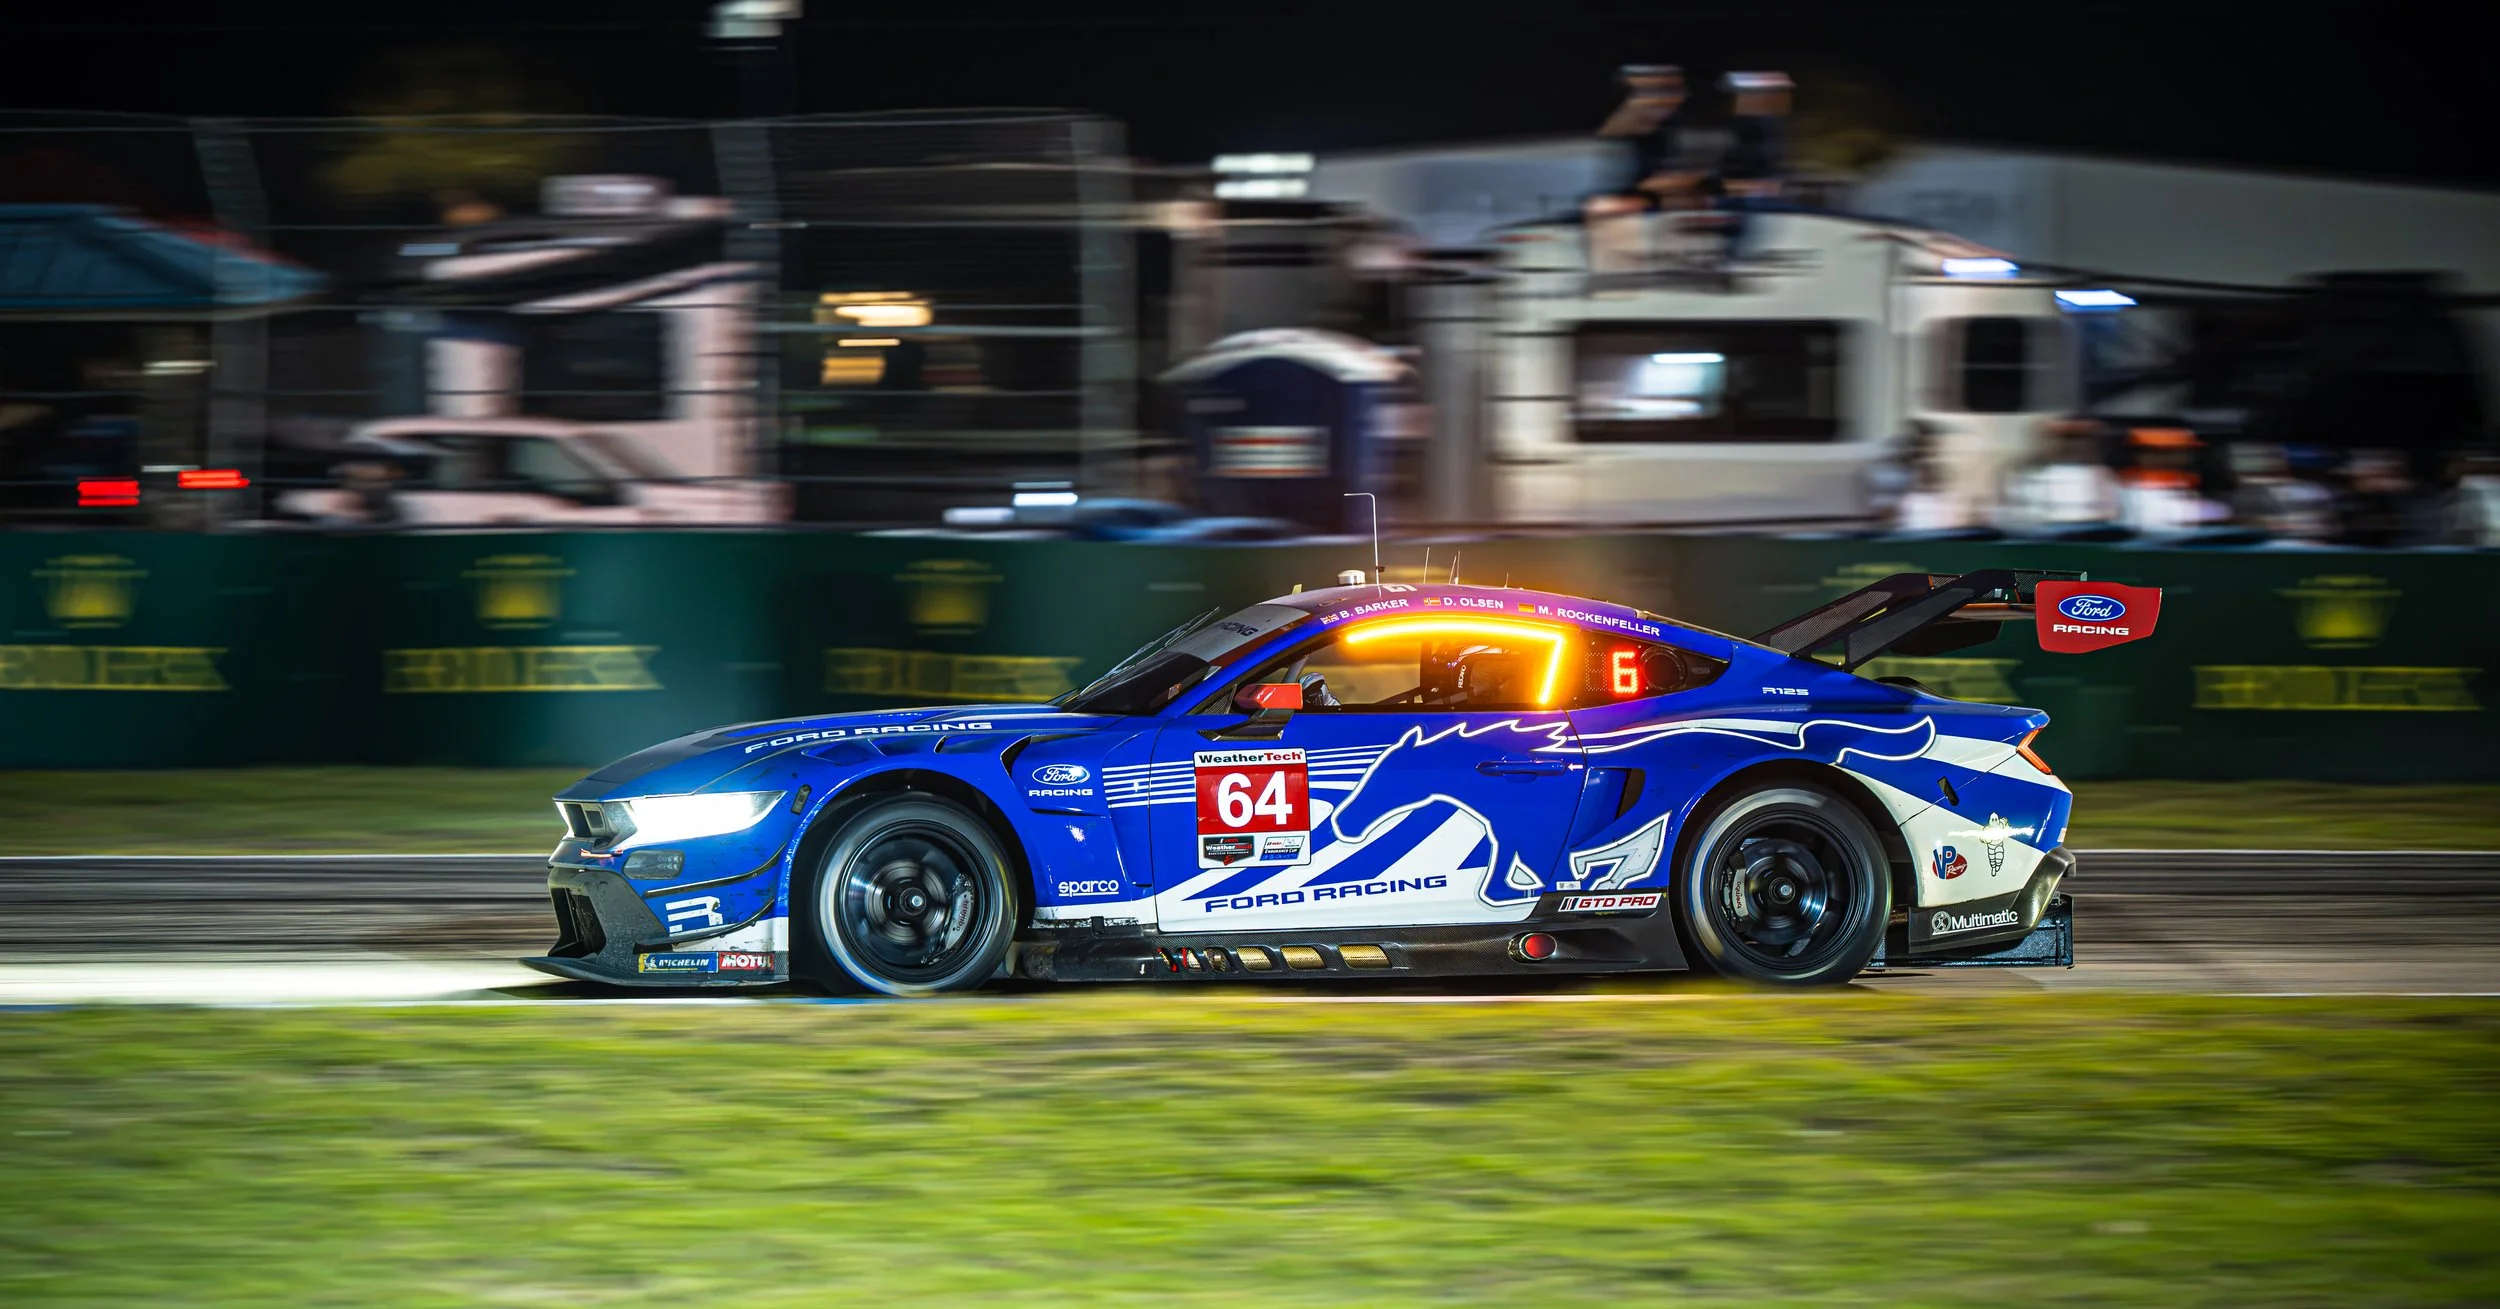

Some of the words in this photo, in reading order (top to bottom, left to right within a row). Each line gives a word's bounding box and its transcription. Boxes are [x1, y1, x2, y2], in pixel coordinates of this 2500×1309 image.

[1340, 609, 1352, 619] B.
[1355, 598, 1409, 616] BARKER
[1443, 597, 1457, 606] D.
[1459, 597, 1504, 609] OLSEN
[2071, 598, 2113, 617] Ford
[1538, 605, 1553, 616] M.
[1557, 607, 1661, 637] ROCKENFELLER
[2053, 624, 2130, 636] RACING
[1612, 651, 1638, 694] 6
[1762, 686, 1809, 696] R125
[745, 729, 847, 754] FORD
[854, 722, 993, 736] RACING
[1198, 752, 1302, 764] WeatherTech
[1028, 788, 1093, 797] RACING
[1217, 770, 1293, 828] 64
[1932, 846, 1957, 880] VP
[1058, 879, 1119, 897] sparco
[1205, 890, 1304, 913] FORD
[1313, 875, 1447, 901] RACING
[1578, 897, 1616, 909] GTD
[1618, 896, 1657, 907] PRO
[1951, 909, 2018, 930] Multimatic
[658, 958, 710, 967] MICHELIN
[721, 955, 772, 968] MOTUL
